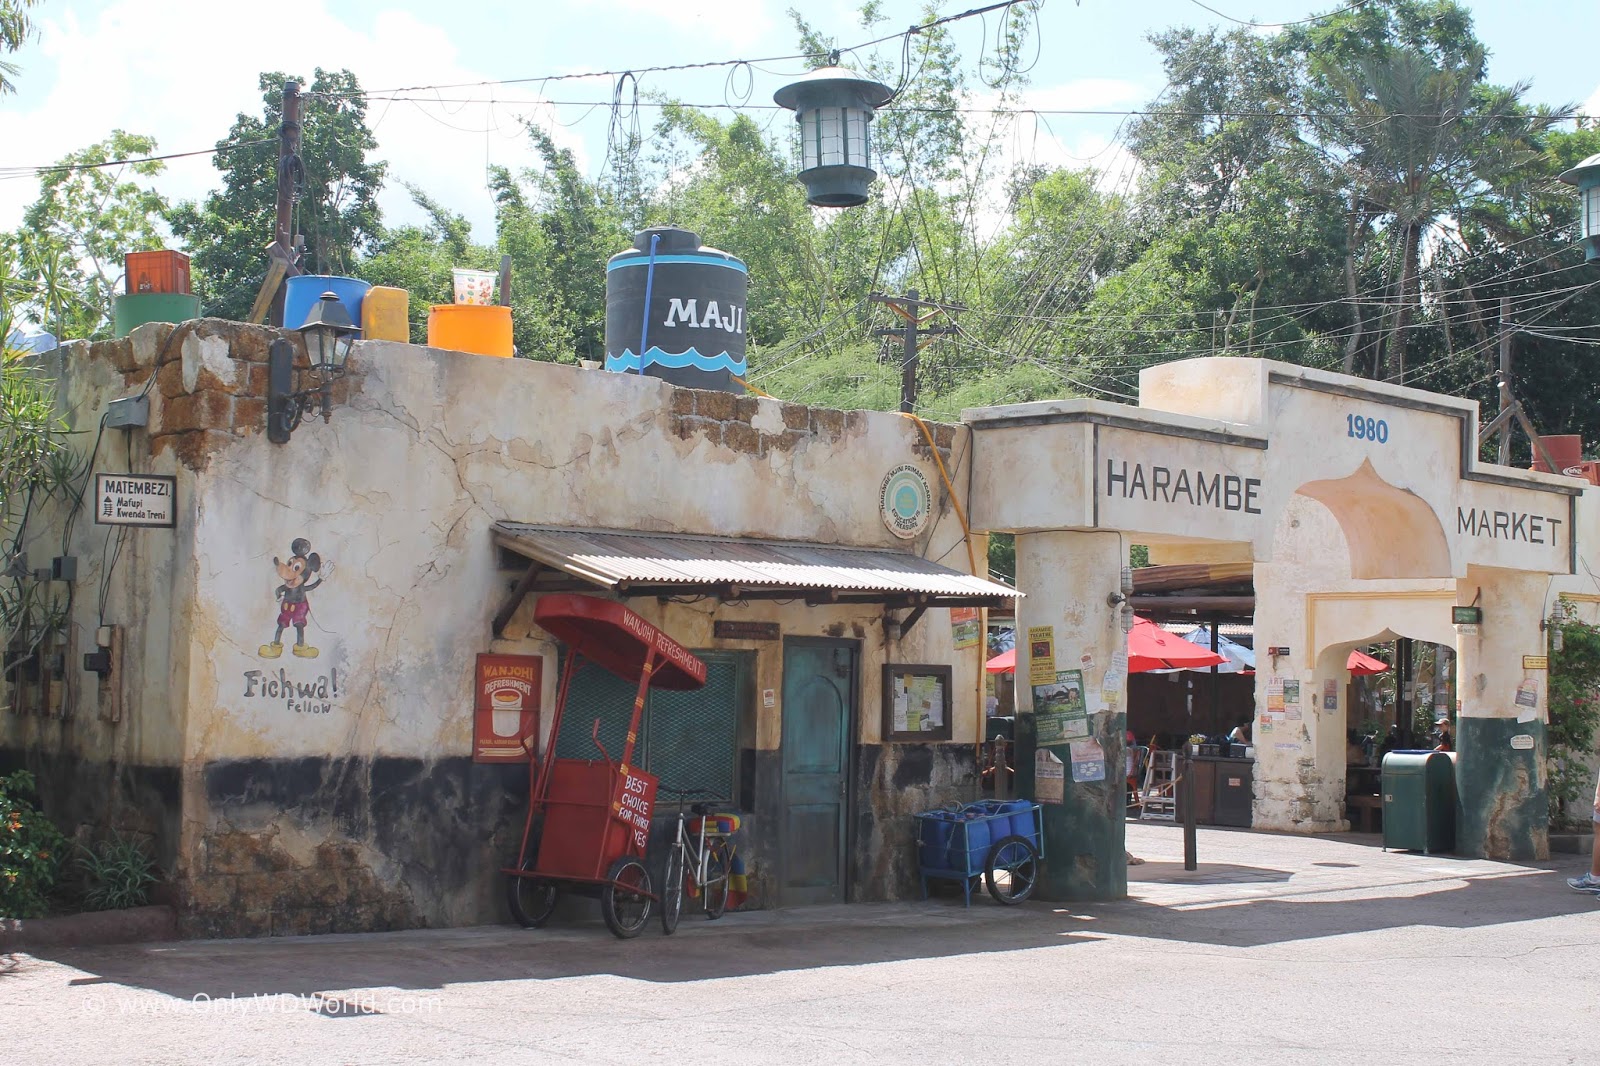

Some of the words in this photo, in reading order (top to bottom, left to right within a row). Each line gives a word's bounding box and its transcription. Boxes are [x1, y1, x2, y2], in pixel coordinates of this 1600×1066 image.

[663, 298, 742, 334] MAJI
[1347, 413, 1389, 444] 1980
[116, 497, 143, 509] Mafupi
[1107, 458, 1262, 515] HARAMBE
[1457, 506, 1562, 547] MARKET
[117, 508, 146, 519] Kwenda
[147, 510, 166, 520] Treni
[623, 610, 655, 643] WANJOHI
[656, 633, 703, 676] REFRESHMENT
[483, 665, 534, 680] WANJOHI
[243, 667, 338, 699] Fichwa!
[484, 679, 532, 696] REFRESHMENT
[287, 699, 331, 714] Fellow
[624, 775, 649, 796] BEST
[621, 793, 649, 815] CHOICE
[618, 807, 633, 822] FOR
[634, 829, 647, 848] YES
